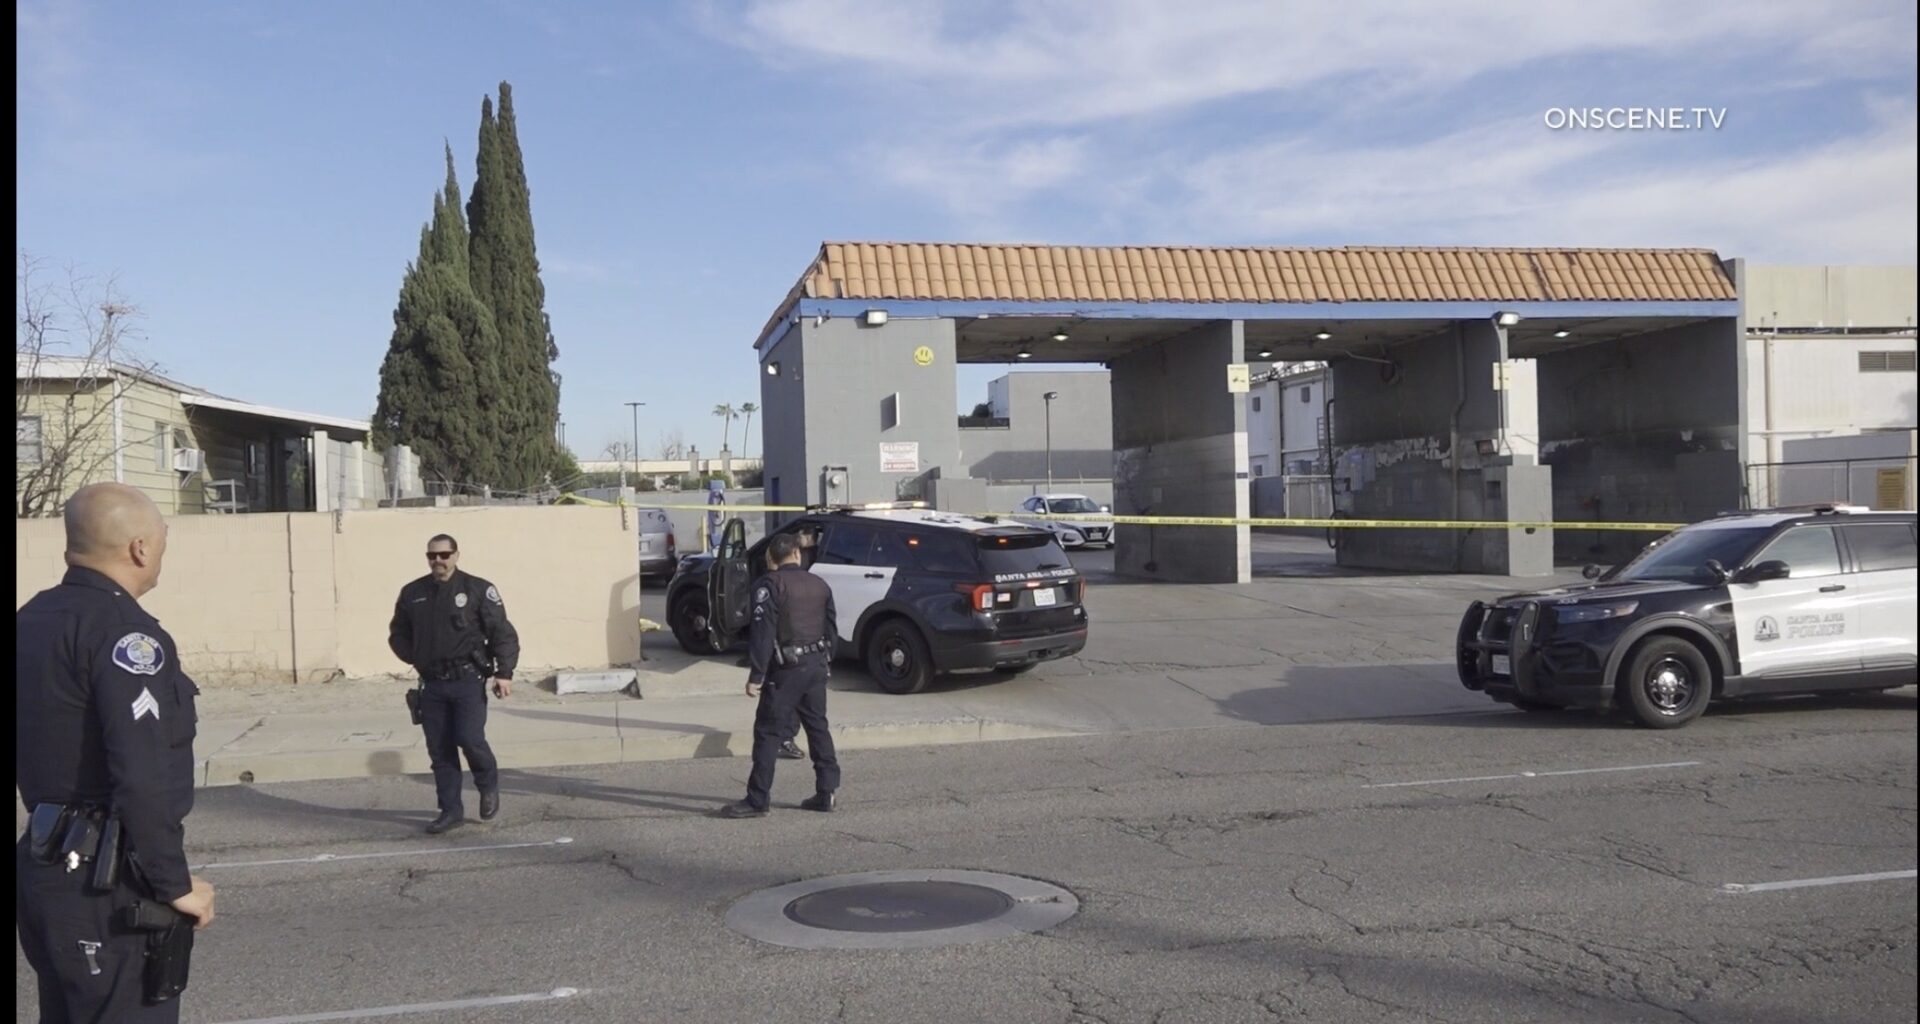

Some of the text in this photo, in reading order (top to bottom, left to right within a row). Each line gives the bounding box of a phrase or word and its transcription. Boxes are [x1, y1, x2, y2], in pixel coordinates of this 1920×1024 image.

[995, 573, 1025, 582] SANTA
[1027, 571, 1044, 579] ANA
[1787, 613, 1844, 624] SANTA ANA
[1787, 623, 1846, 639] POLICE
